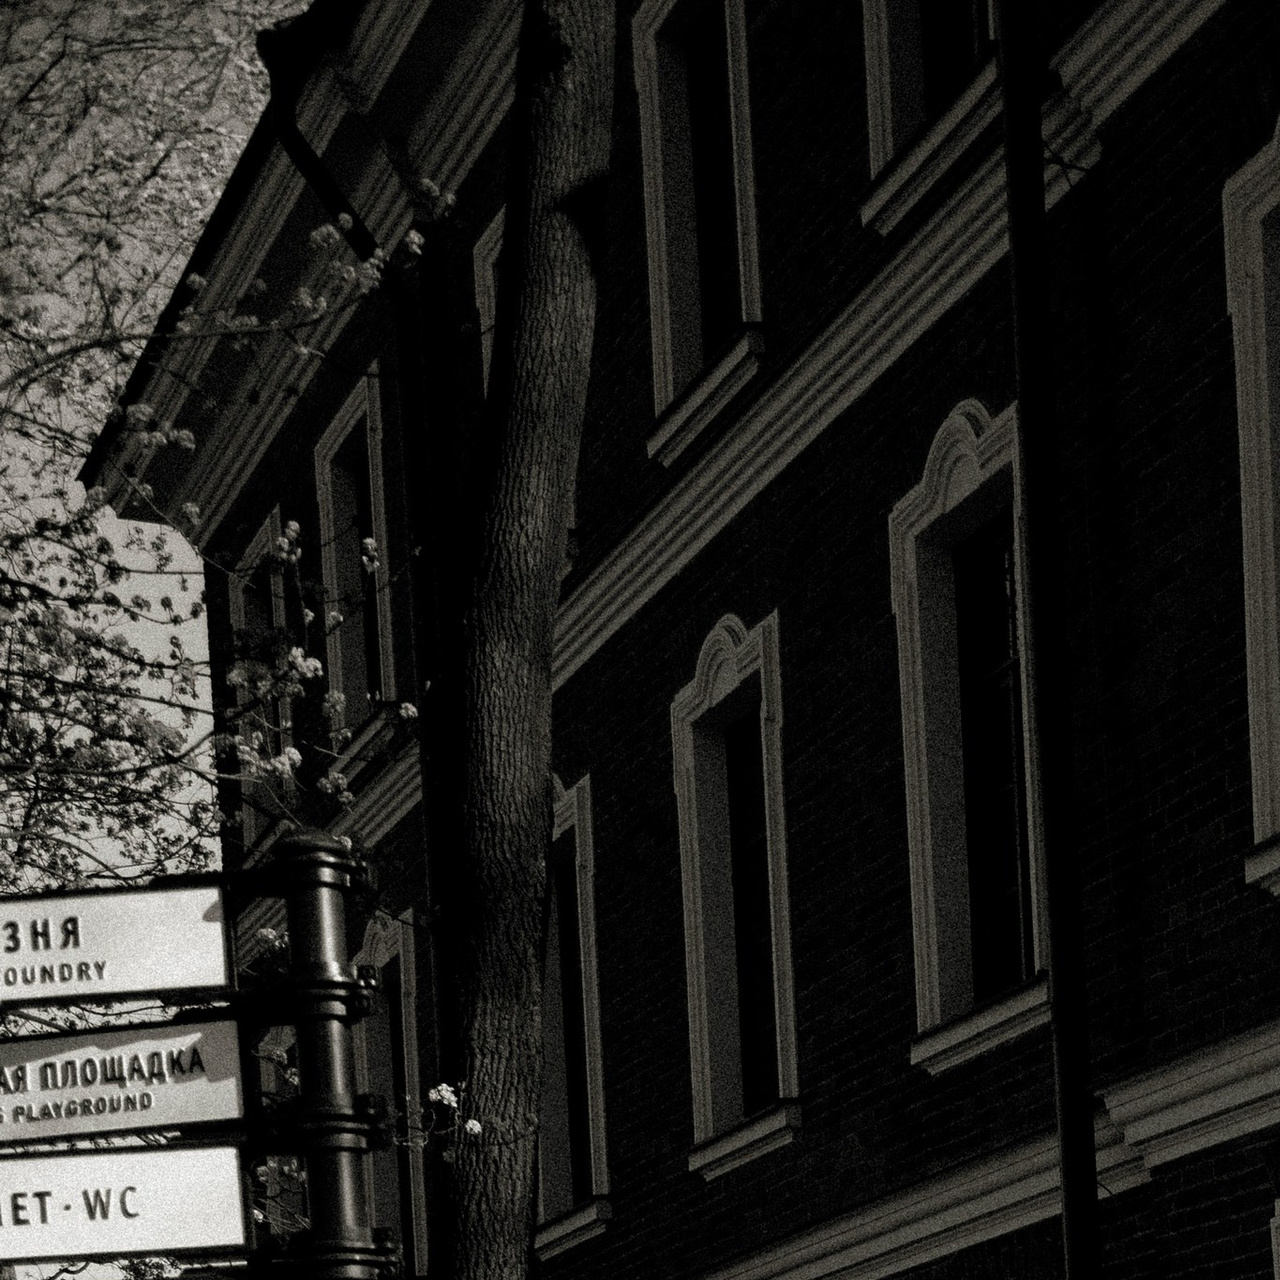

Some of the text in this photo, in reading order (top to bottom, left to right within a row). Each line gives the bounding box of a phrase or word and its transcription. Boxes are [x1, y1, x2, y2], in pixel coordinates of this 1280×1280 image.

[2, 916, 80, 953] ЗНЯ
[4, 960, 107, 986] OUNDRY
[39, 1045, 206, 1092] ПЛОЩАДКА
[12, 1092, 153, 1124] PLAYGROUND
